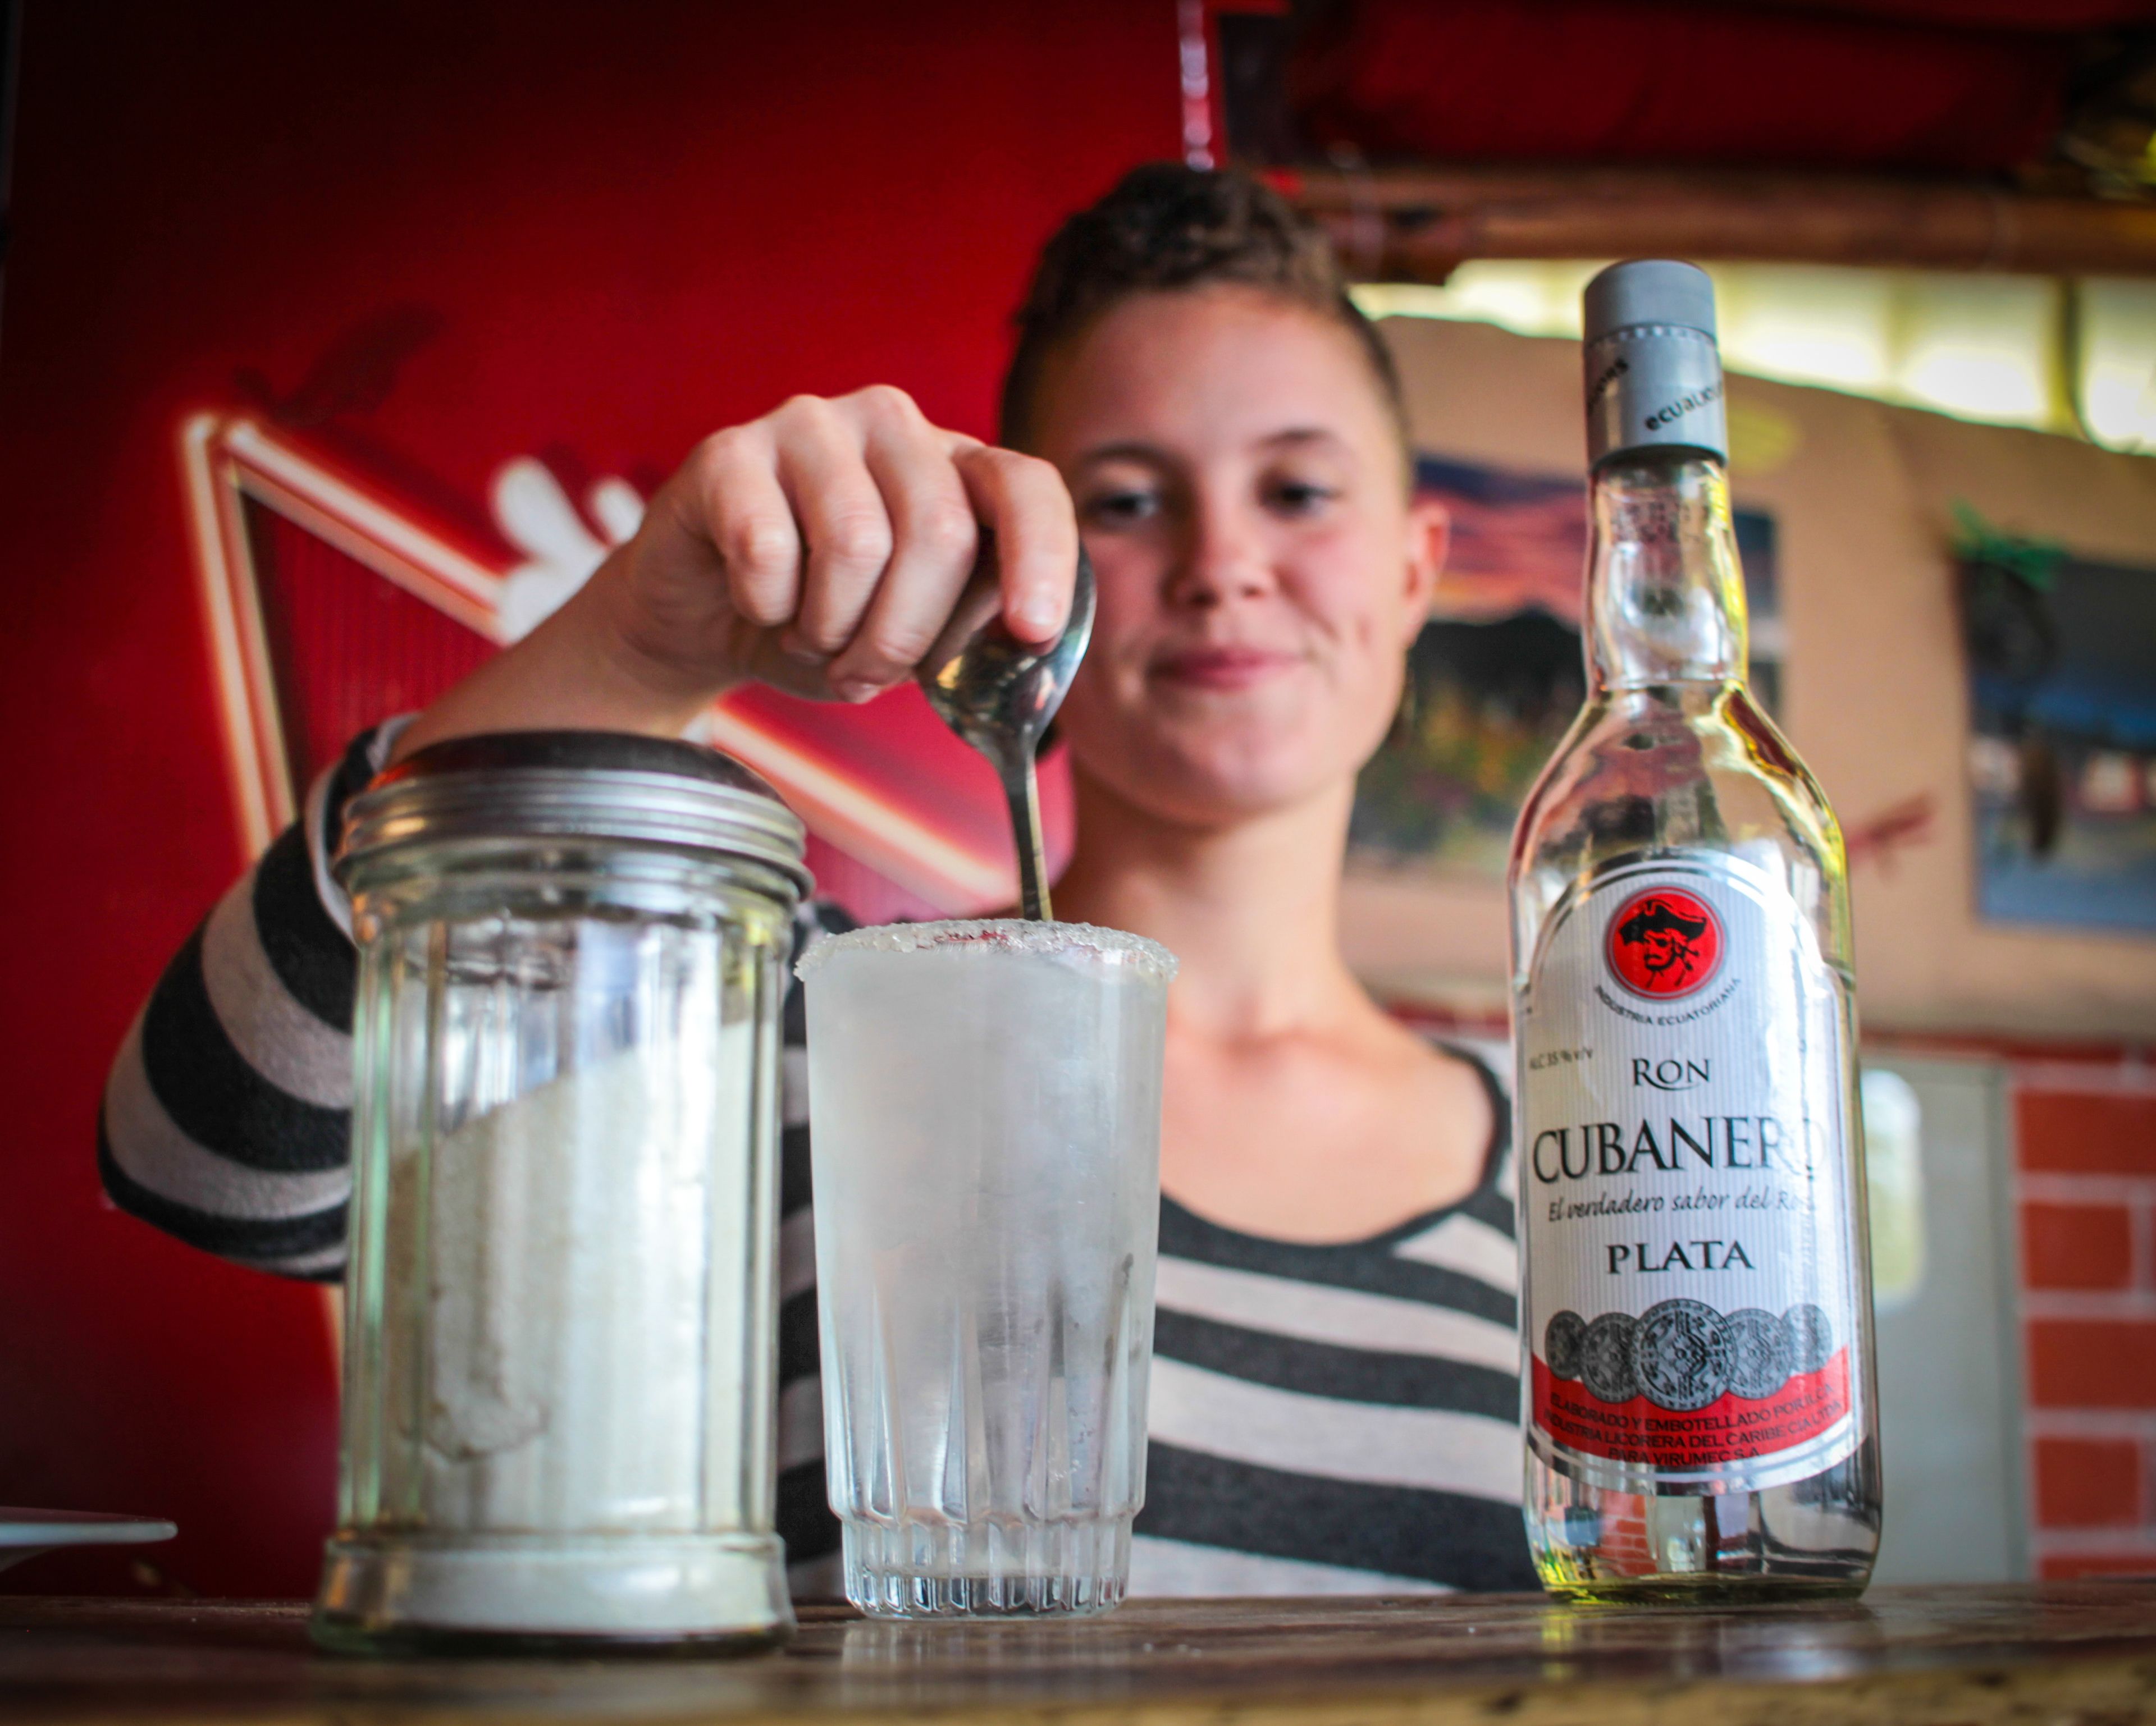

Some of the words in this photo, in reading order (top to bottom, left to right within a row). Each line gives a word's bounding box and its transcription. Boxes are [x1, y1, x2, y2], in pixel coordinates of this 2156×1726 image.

[1657, 977, 1740, 1026] ECUATORIANA
[1632, 1057, 1711, 1091] RON
[1549, 1196, 1564, 1222] El
[1567, 1188, 1664, 1219] verdadero
[1671, 1185, 1730, 1211] sabor
[1735, 1185, 1770, 1210] del
[1606, 1239, 1756, 1275] PLATA
[1551, 1391, 1629, 1429] ELABORADO
[1632, 1417, 1643, 1430] Y
[1646, 1408, 1771, 1432] EMBOTELLADO
[1773, 1397, 1805, 1418] POR
[1604, 1431, 1687, 1448] LICORERA
[1689, 1434, 1724, 1448] DEL
[1726, 1425, 1787, 1446] CARIBE
[1607, 1446, 1650, 1464] PARA
